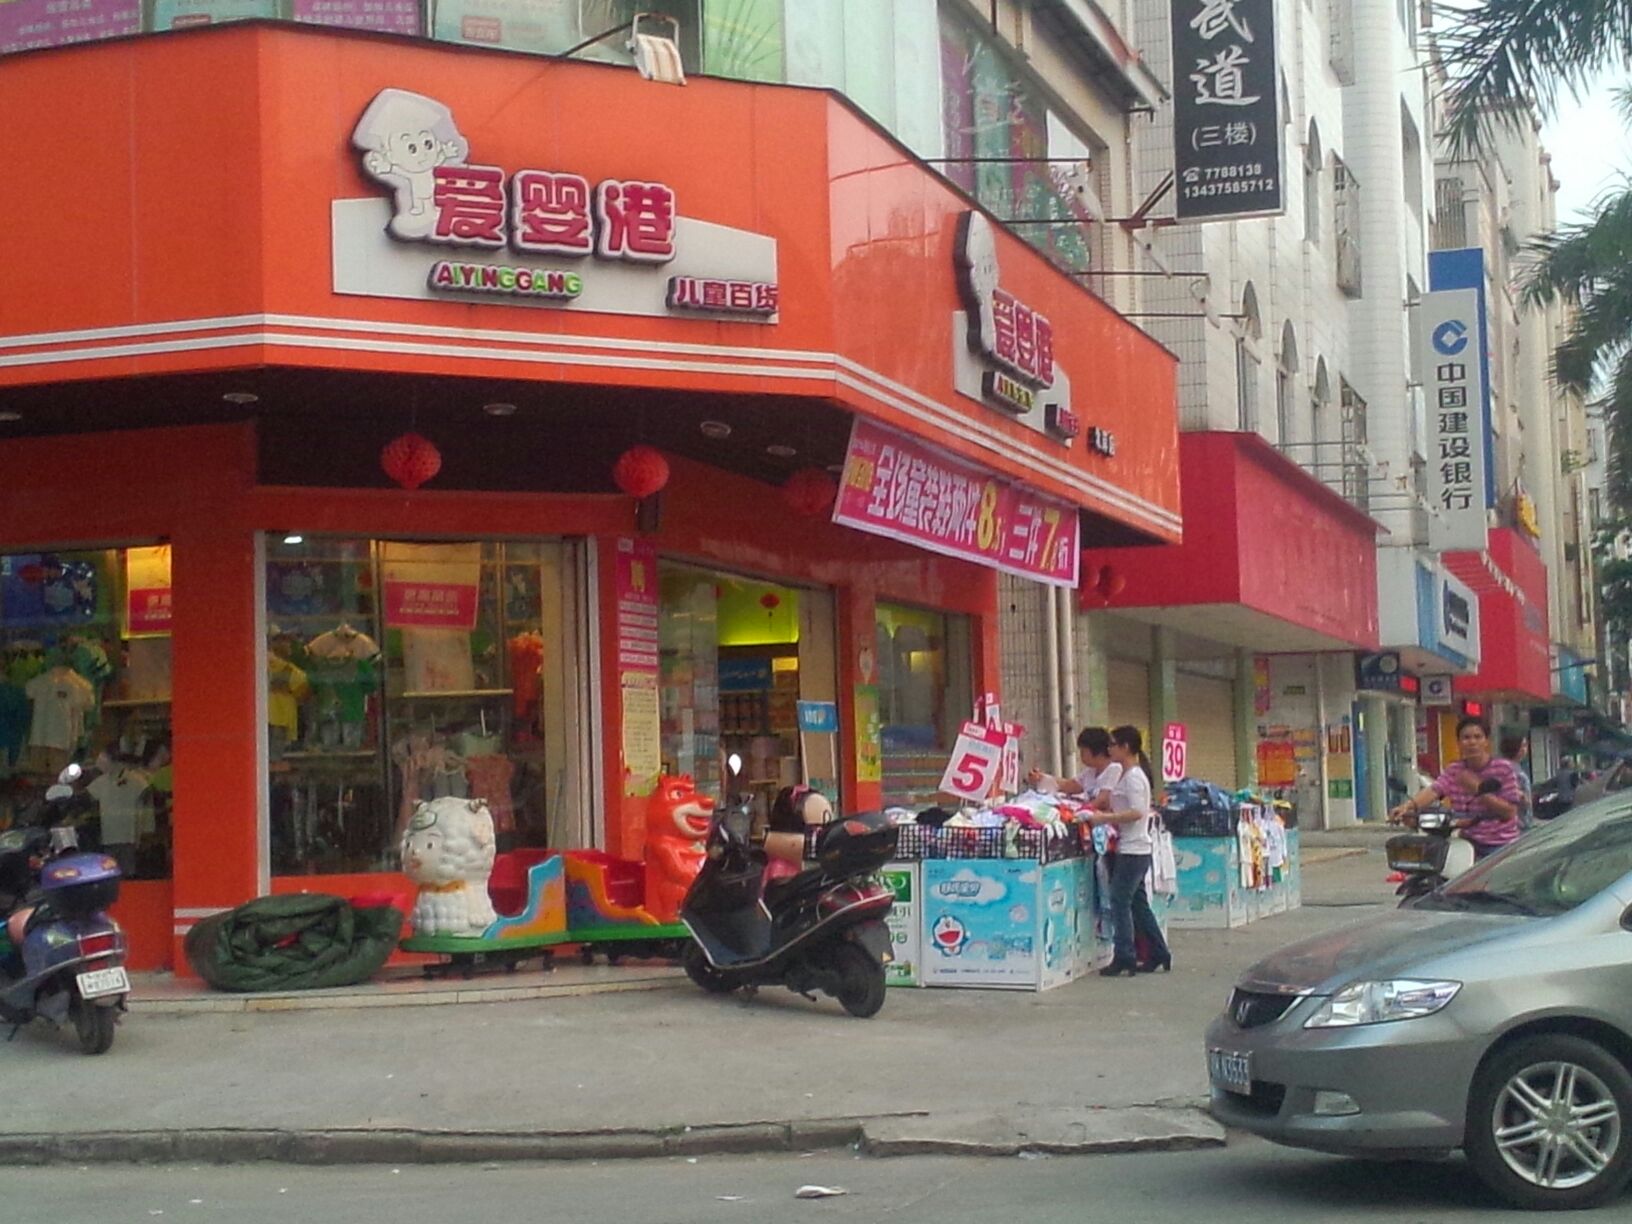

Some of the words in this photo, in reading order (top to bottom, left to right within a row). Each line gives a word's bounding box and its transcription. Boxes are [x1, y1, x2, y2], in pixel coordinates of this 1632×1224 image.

[432, 164, 676, 260] 爱婴港
[436, 263, 583, 296] AIYINGGANG
[676, 278, 778, 310] 儿童百货
[1437, 362, 1474, 510] 中国建设银行
[951, 752, 989, 793] 5
[1006, 750, 1017, 785] 15
[1164, 741, 1184, 778] 39
